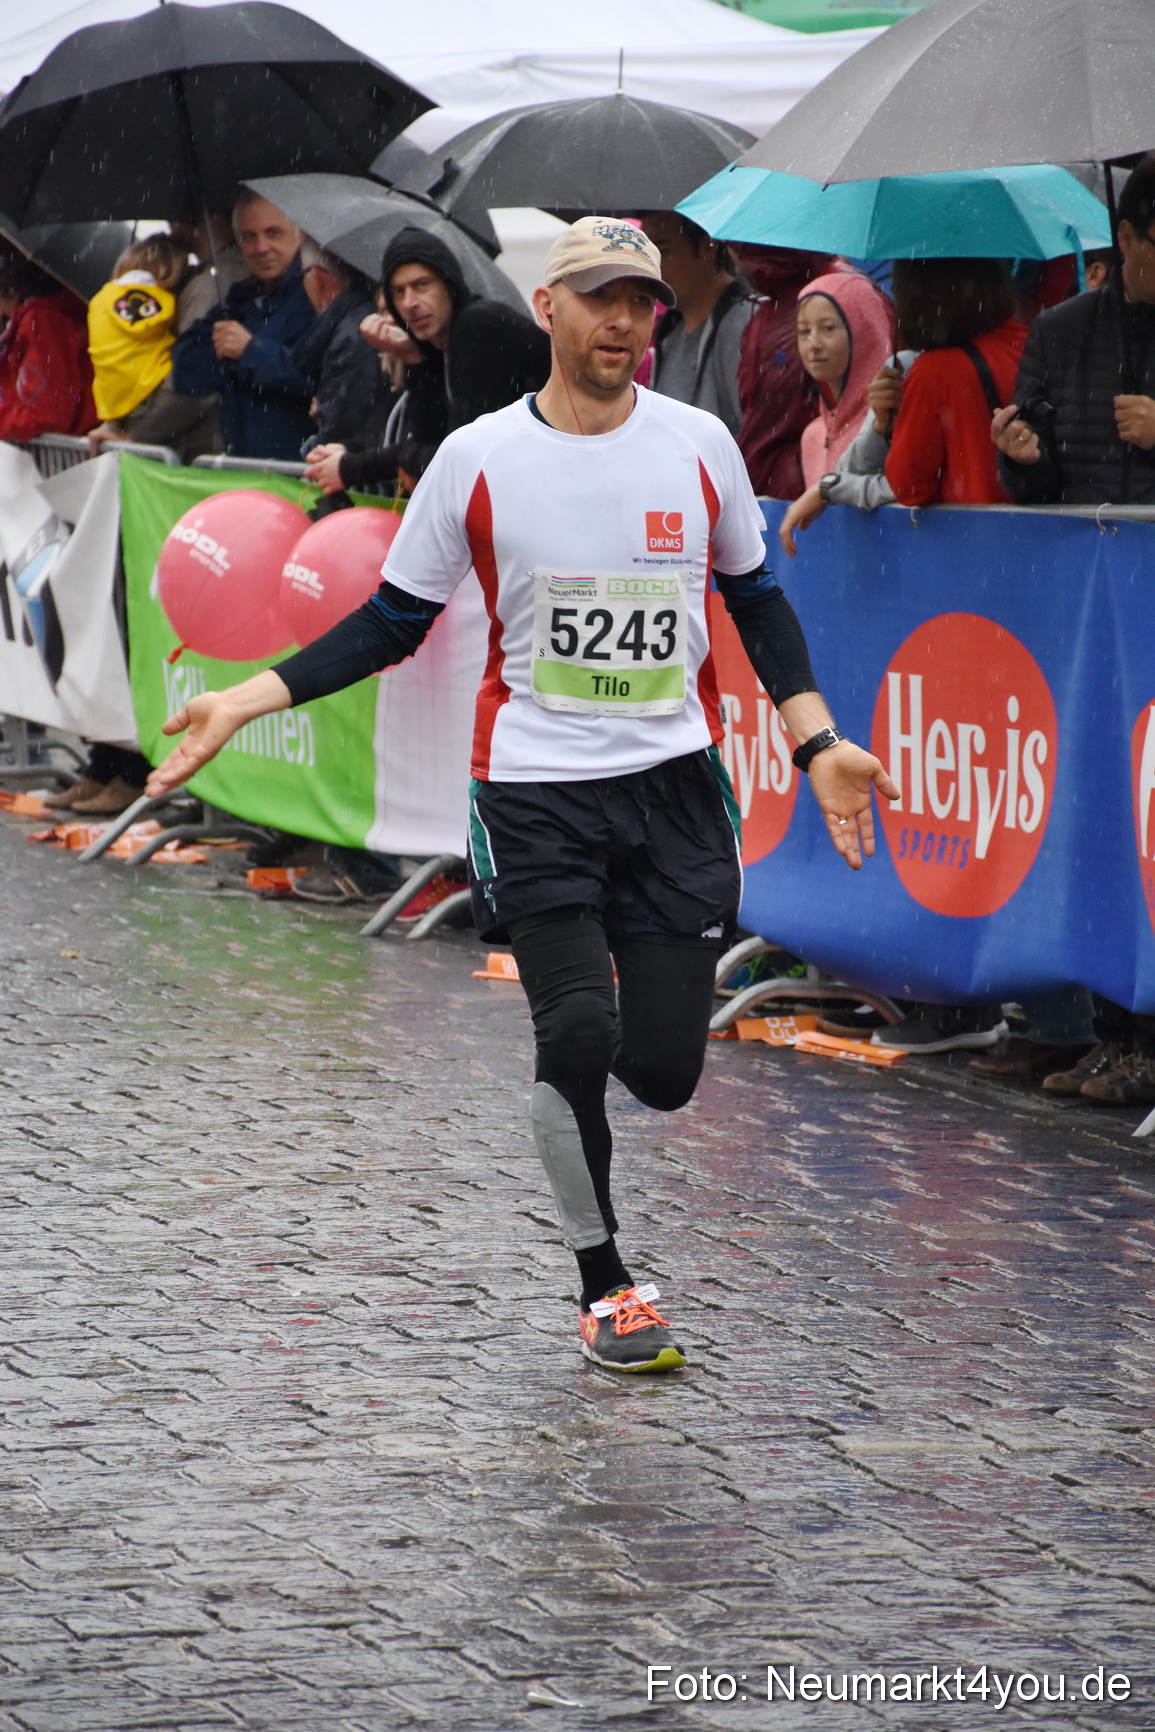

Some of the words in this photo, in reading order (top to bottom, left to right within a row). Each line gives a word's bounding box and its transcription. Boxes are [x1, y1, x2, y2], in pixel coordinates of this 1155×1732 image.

[649, 537, 682, 549] DKMS
[548, 586, 598, 598] NeuerMarkt
[607, 577, 680, 596] BOCK
[550, 607, 677, 660] 5243
[538, 648, 546, 659] S
[591, 675, 630, 697] Tilo
[719, 677, 792, 820] rvis
[887, 671, 1048, 859] Hervis
[898, 827, 971, 869] SPORTS
